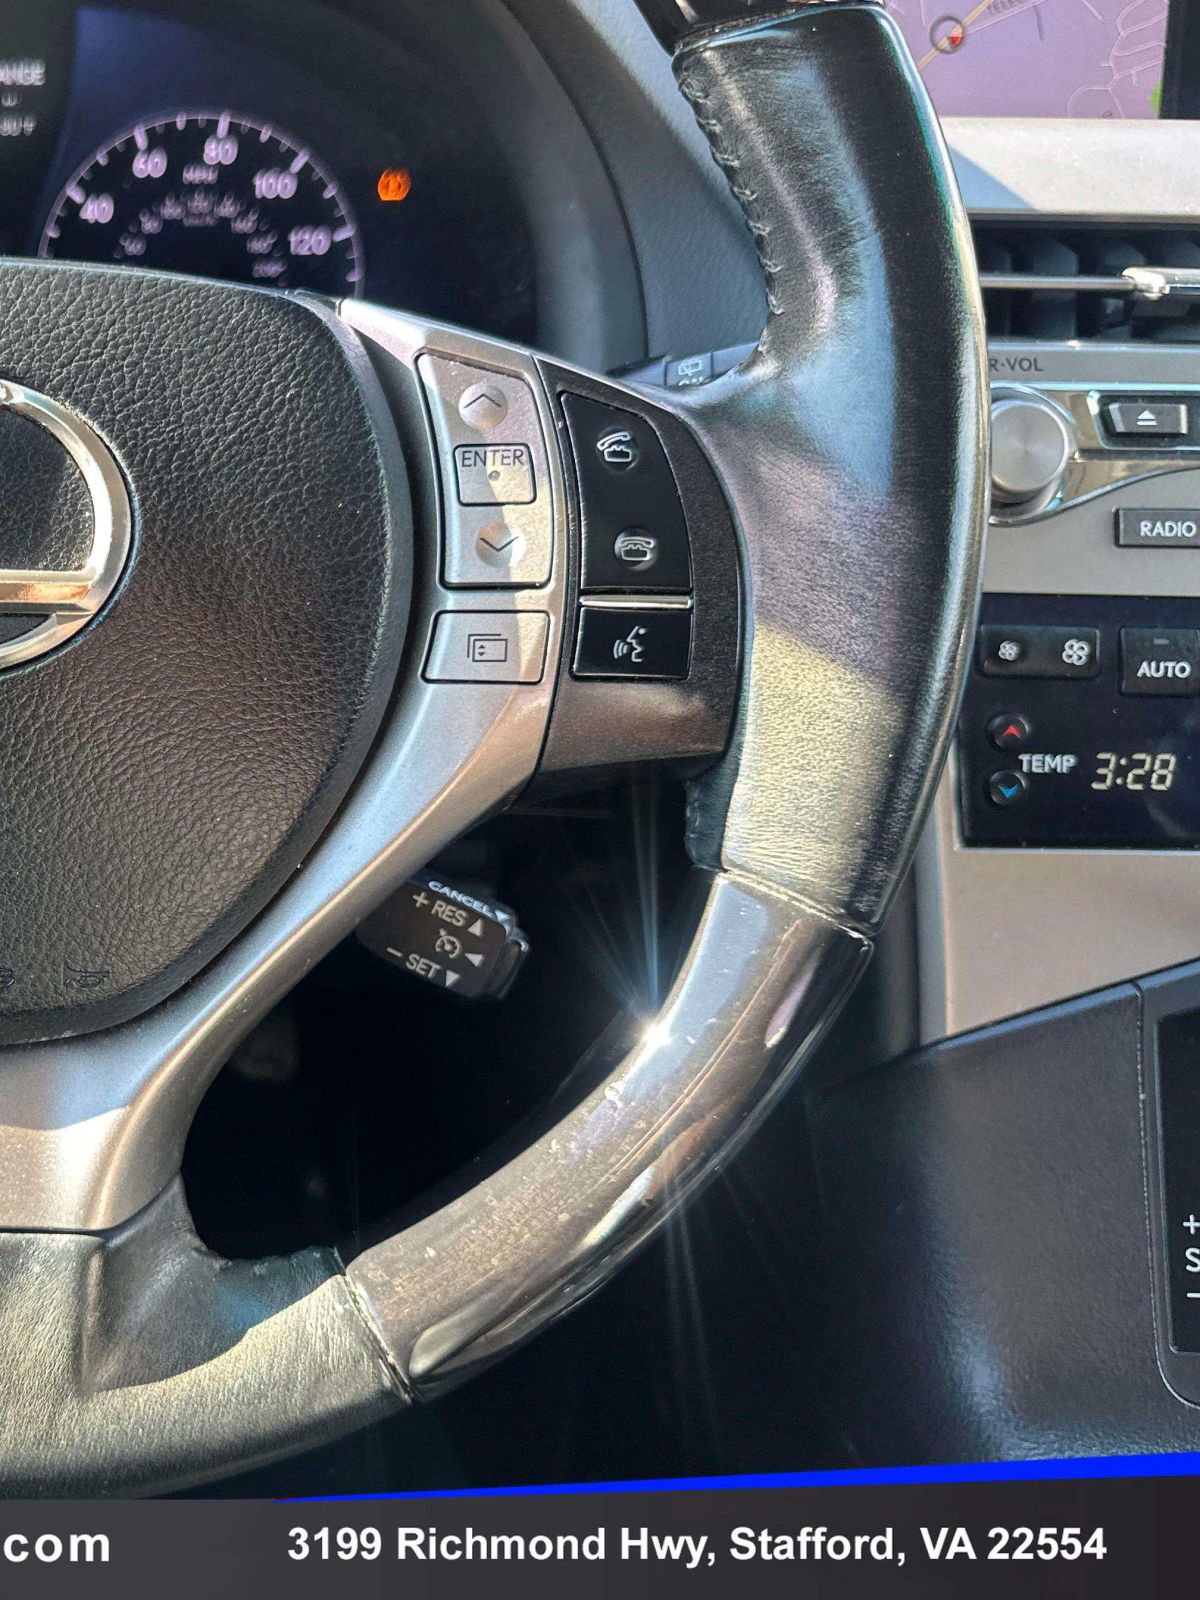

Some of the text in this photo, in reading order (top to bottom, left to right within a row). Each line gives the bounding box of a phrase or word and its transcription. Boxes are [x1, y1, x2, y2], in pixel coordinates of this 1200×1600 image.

[133, 148, 167, 178] 60
[204, 134, 238, 165] 80
[254, 168, 298, 199] 100
[79, 194, 114, 223] 40
[289, 225, 332, 256] 120
[461, 448, 525, 468] ENTER
[1140, 520, 1197, 538] RADIO
[1137, 660, 1192, 679] AUTO
[1018, 753, 1078, 774] TEMP
[1091, 752, 1177, 791] 3:28
[428, 880, 496, 919] CANCEL
[431, 900, 468, 927] RES
[405, 953, 442, 979] SET
